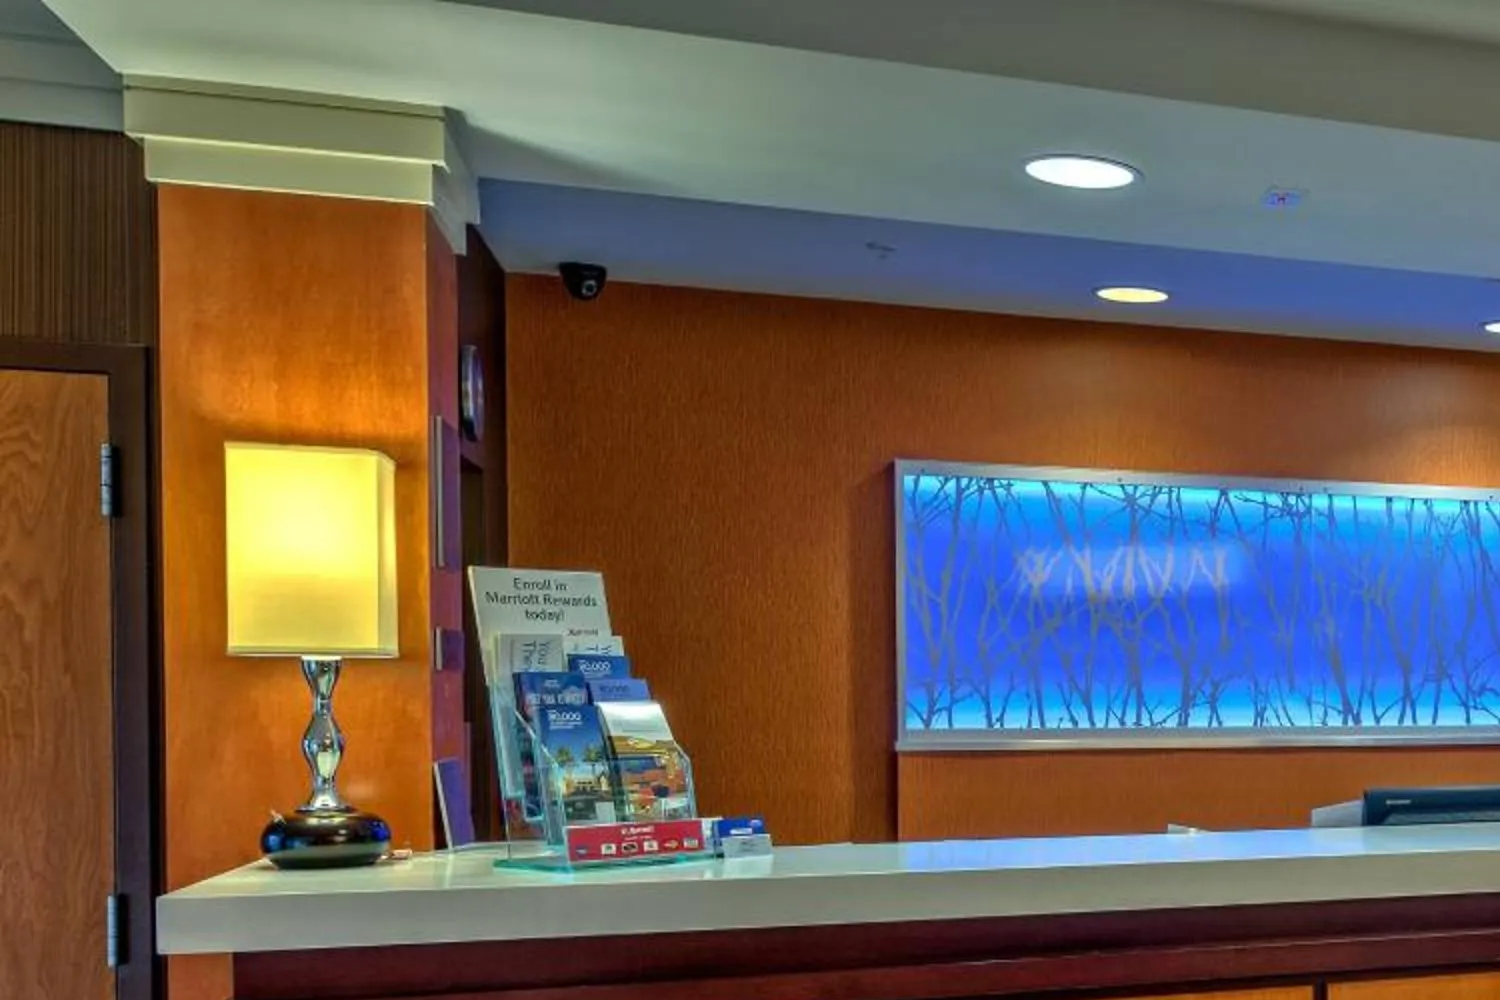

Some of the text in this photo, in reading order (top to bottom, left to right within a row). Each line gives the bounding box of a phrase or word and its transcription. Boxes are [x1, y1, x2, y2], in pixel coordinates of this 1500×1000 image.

[513, 577, 568, 591] Enroll in
[485, 591, 598, 607] Marriott Rewards
[525, 609, 565, 624] today!
